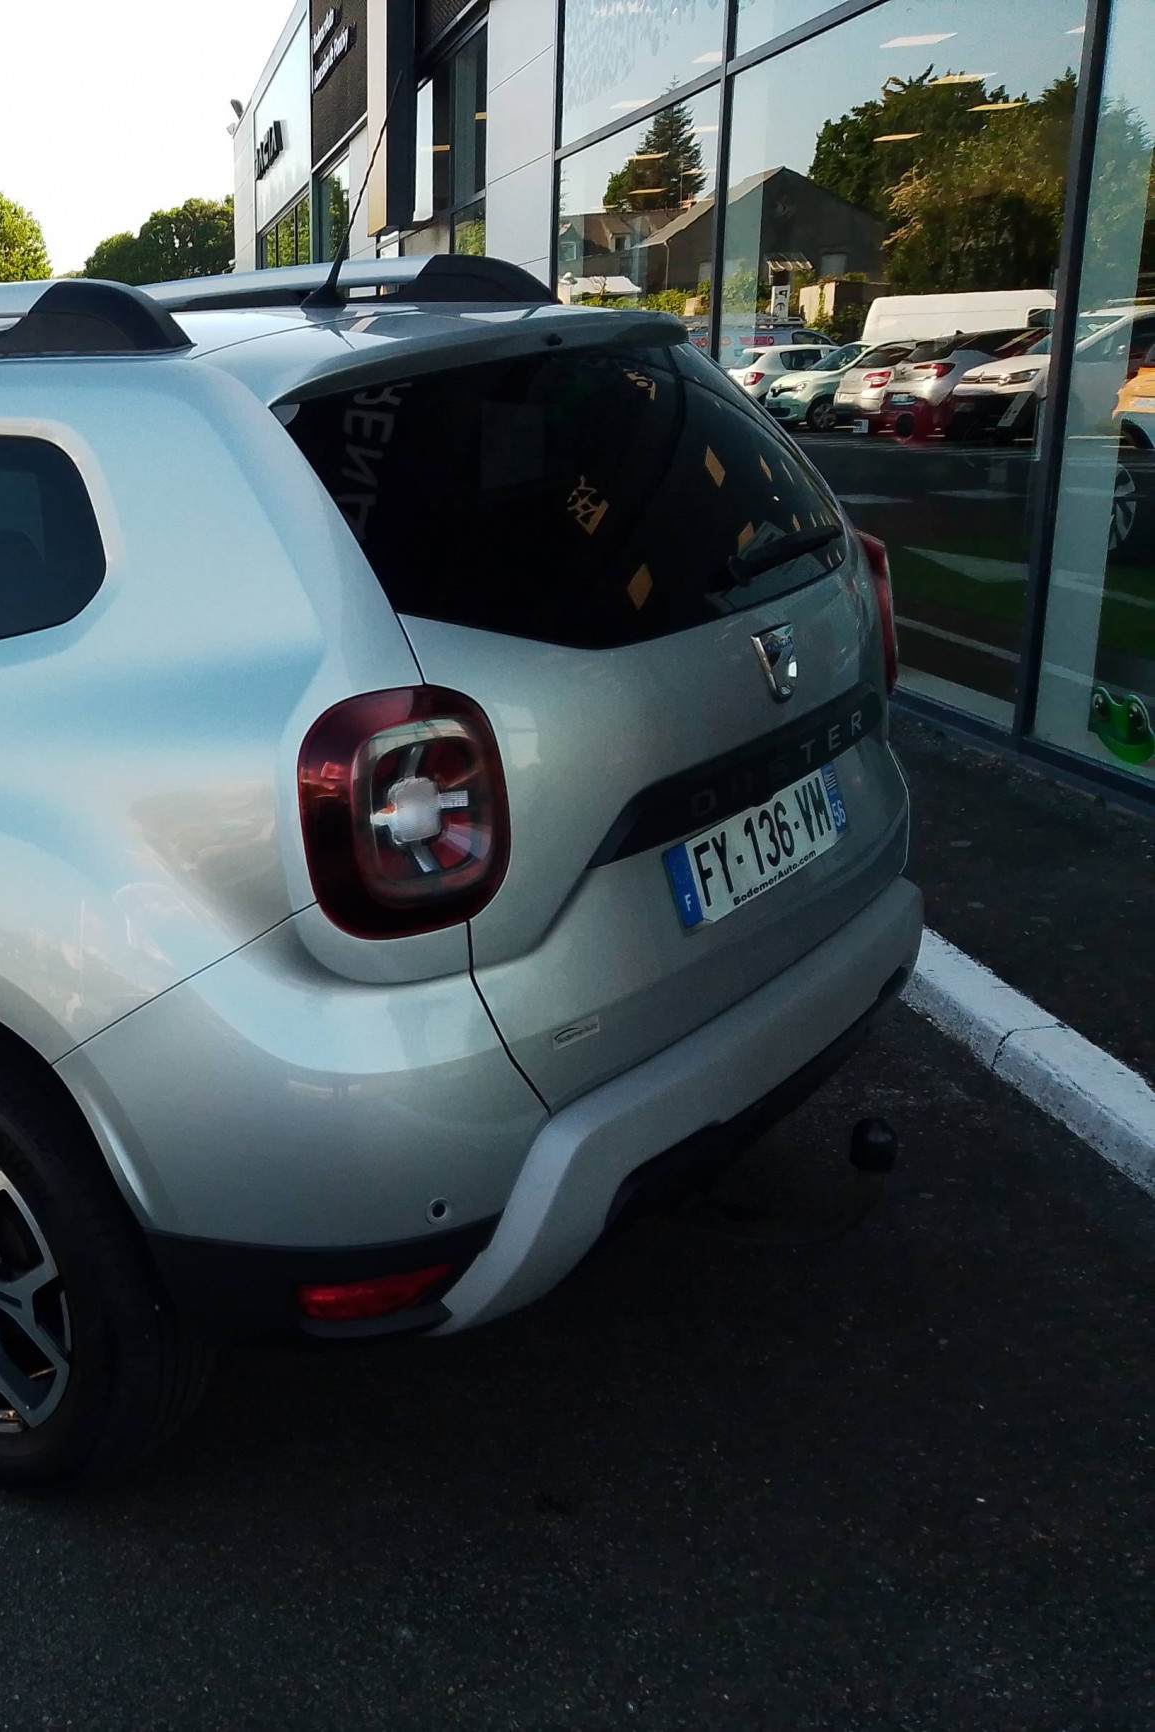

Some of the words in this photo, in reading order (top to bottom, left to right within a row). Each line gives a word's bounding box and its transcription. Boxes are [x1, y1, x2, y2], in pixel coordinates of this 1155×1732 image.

[831, 799, 846, 827] 56
[694, 776, 832, 907] FY-136-VM
[733, 850, 817, 906] BodemerAuto.com
[684, 893, 692, 911] F
